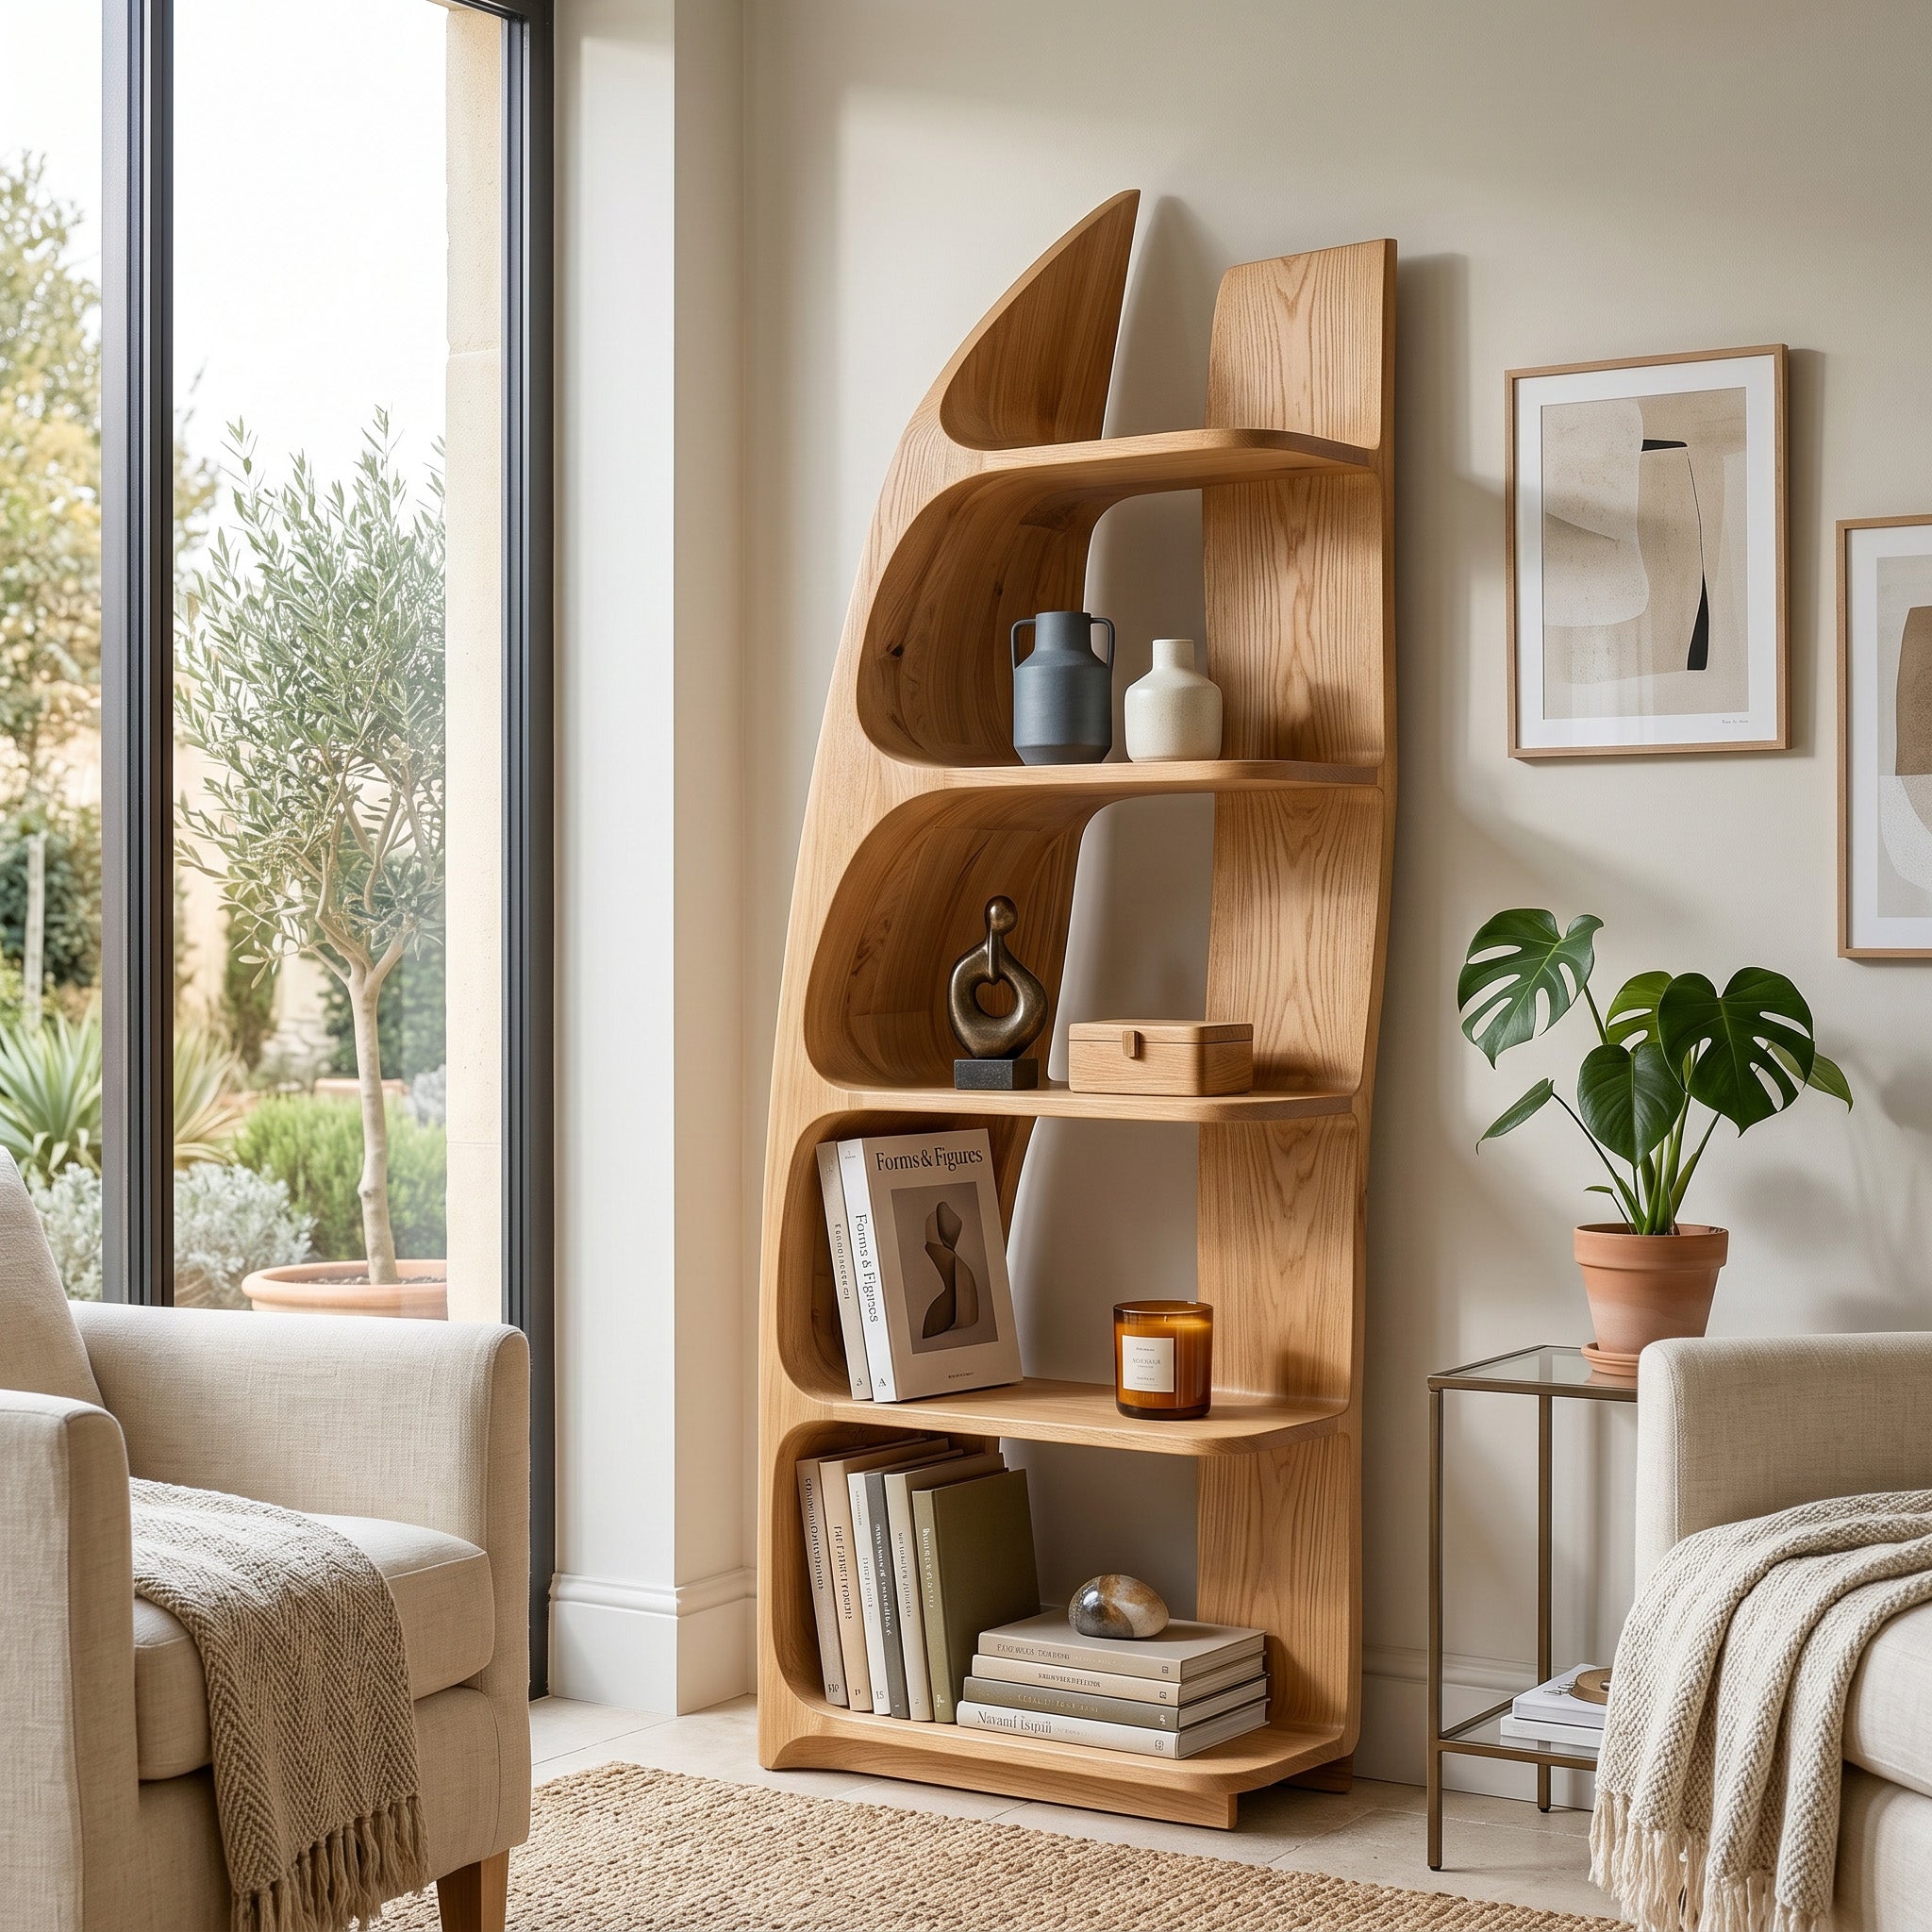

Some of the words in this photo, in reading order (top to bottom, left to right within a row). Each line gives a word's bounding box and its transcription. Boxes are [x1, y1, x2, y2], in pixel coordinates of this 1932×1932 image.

[875, 1152, 920, 1171] Forms
[921, 1149, 932, 1167] &
[934, 1147, 983, 1172] Figures
[856, 1213, 868, 1257] Forms
